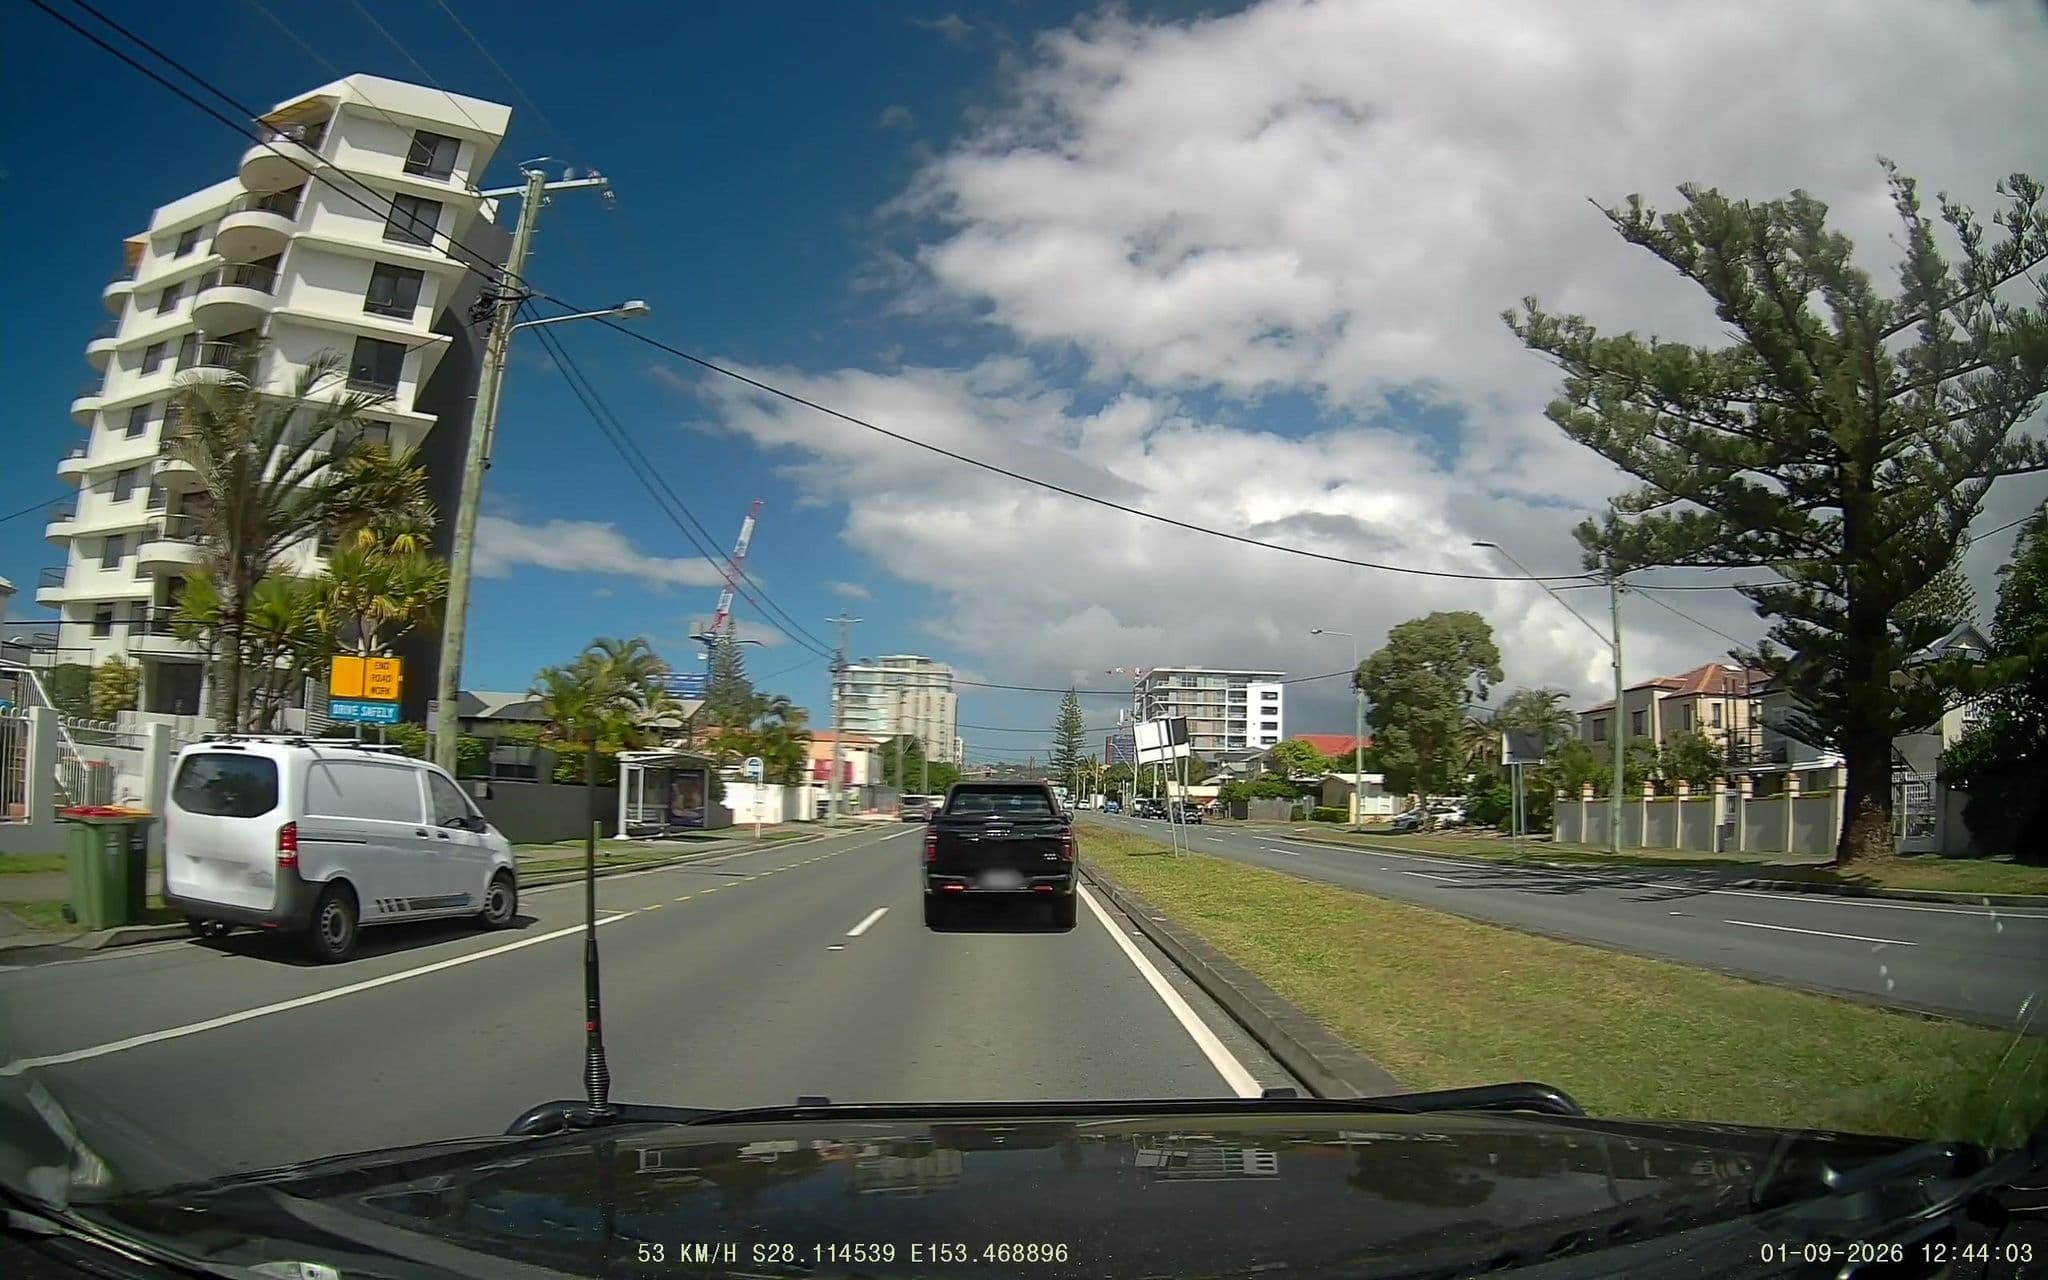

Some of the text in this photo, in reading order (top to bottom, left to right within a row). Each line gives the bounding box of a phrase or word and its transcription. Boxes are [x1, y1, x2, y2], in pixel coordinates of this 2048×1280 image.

[375, 661, 390, 670] END
[370, 673, 392, 683] ROAD
[371, 686, 390, 695] WORK
[332, 704, 395, 718] DRIVE SAFELY
